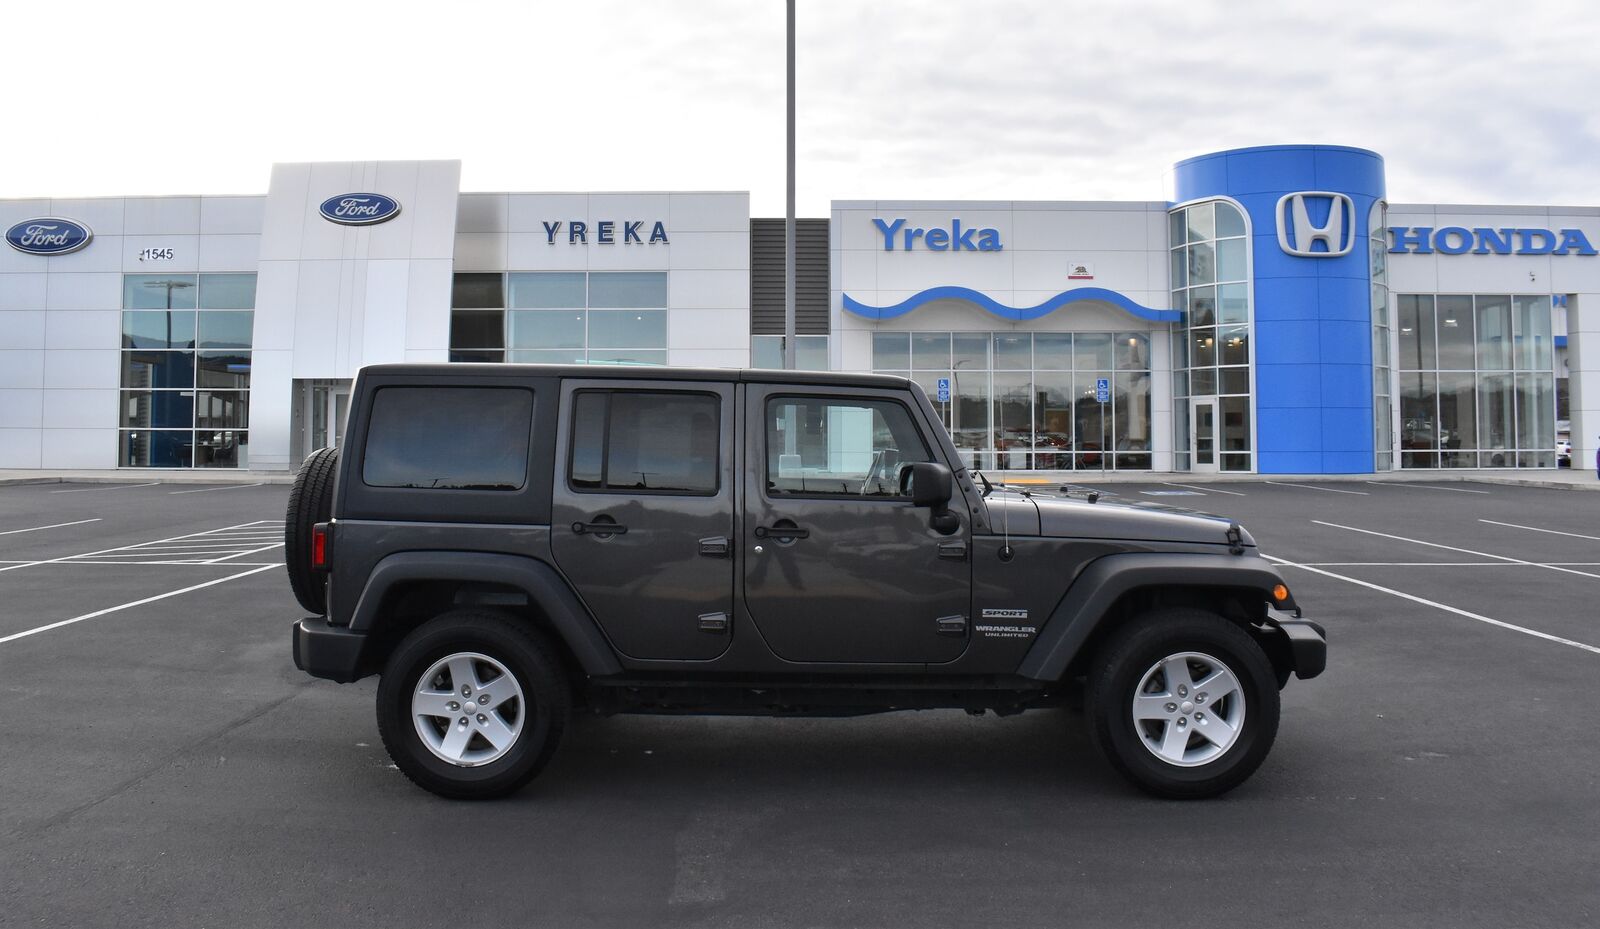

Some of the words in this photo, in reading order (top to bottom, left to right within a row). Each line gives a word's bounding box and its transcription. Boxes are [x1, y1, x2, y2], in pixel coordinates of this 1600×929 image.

[335, 198, 381, 215] Ford
[20, 224, 70, 246] Ford
[543, 221, 670, 244] YREKA
[872, 218, 1003, 252] Yreka
[1387, 226, 1599, 256] HONDA
[145, 248, 174, 260] 1545
[975, 625, 1036, 633] WRANGLER
